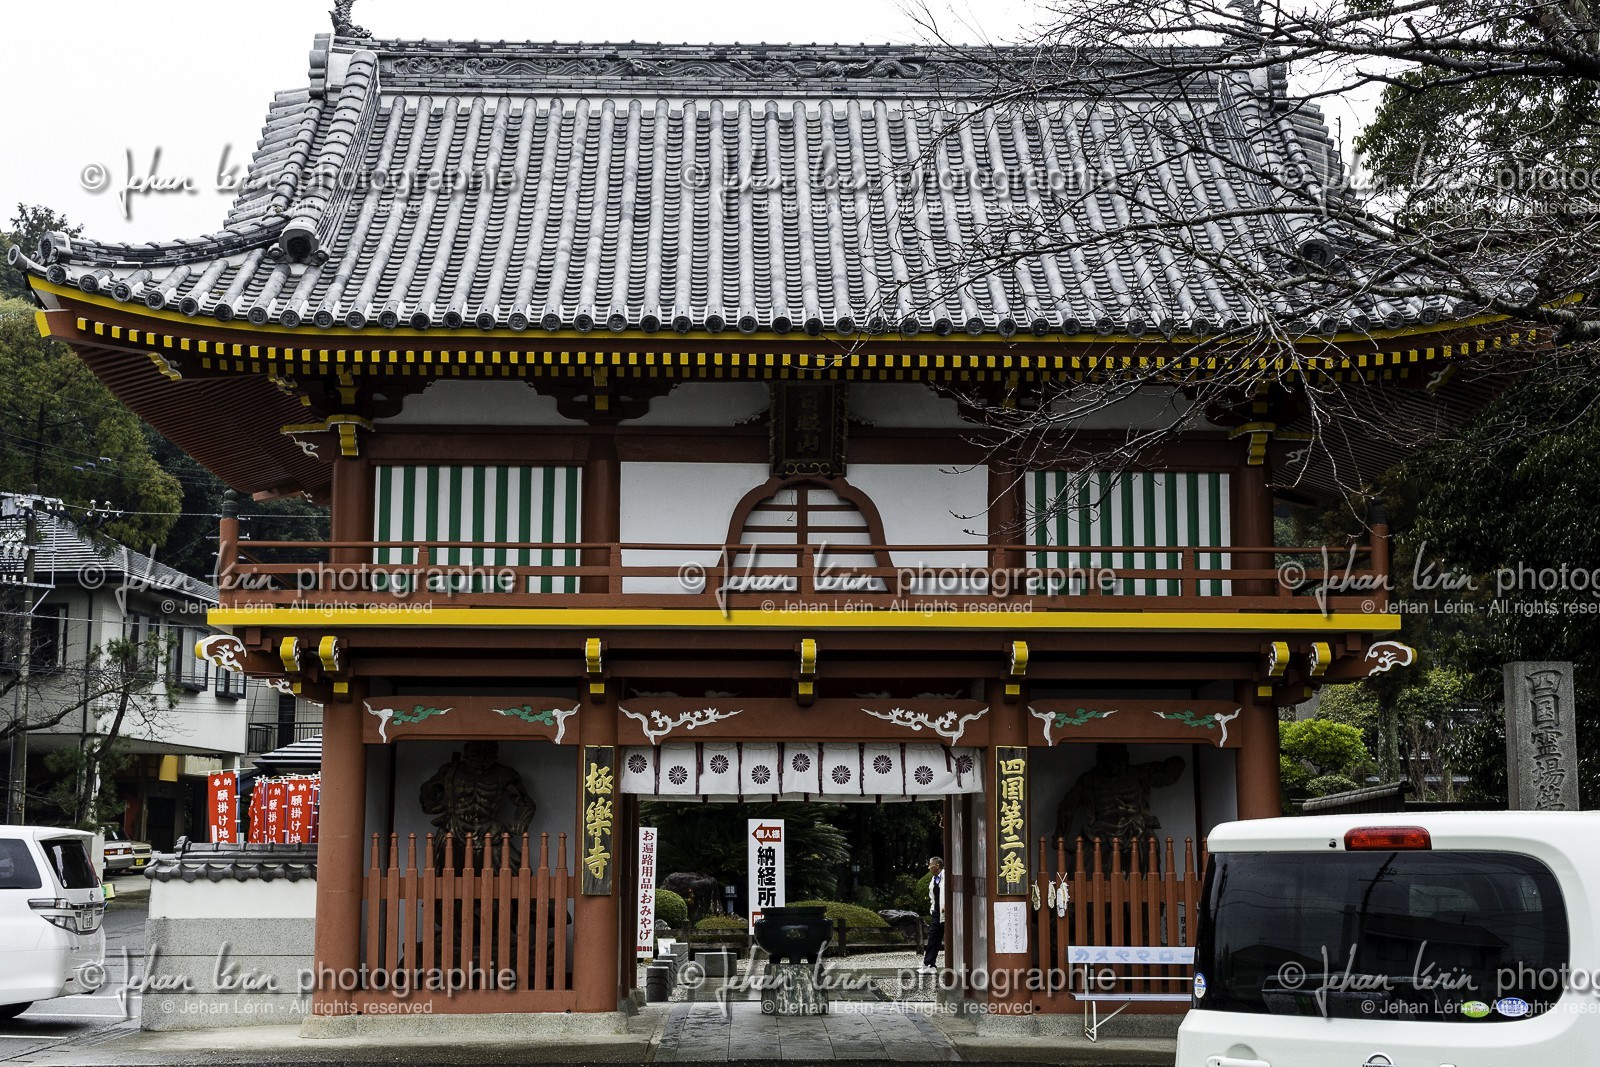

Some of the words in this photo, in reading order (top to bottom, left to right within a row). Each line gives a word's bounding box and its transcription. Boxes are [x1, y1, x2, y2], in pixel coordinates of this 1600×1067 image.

[217, 789, 229, 843] 願掛け地
[999, 757, 1027, 884] 四国第二番
[757, 845, 777, 907] 納経所
